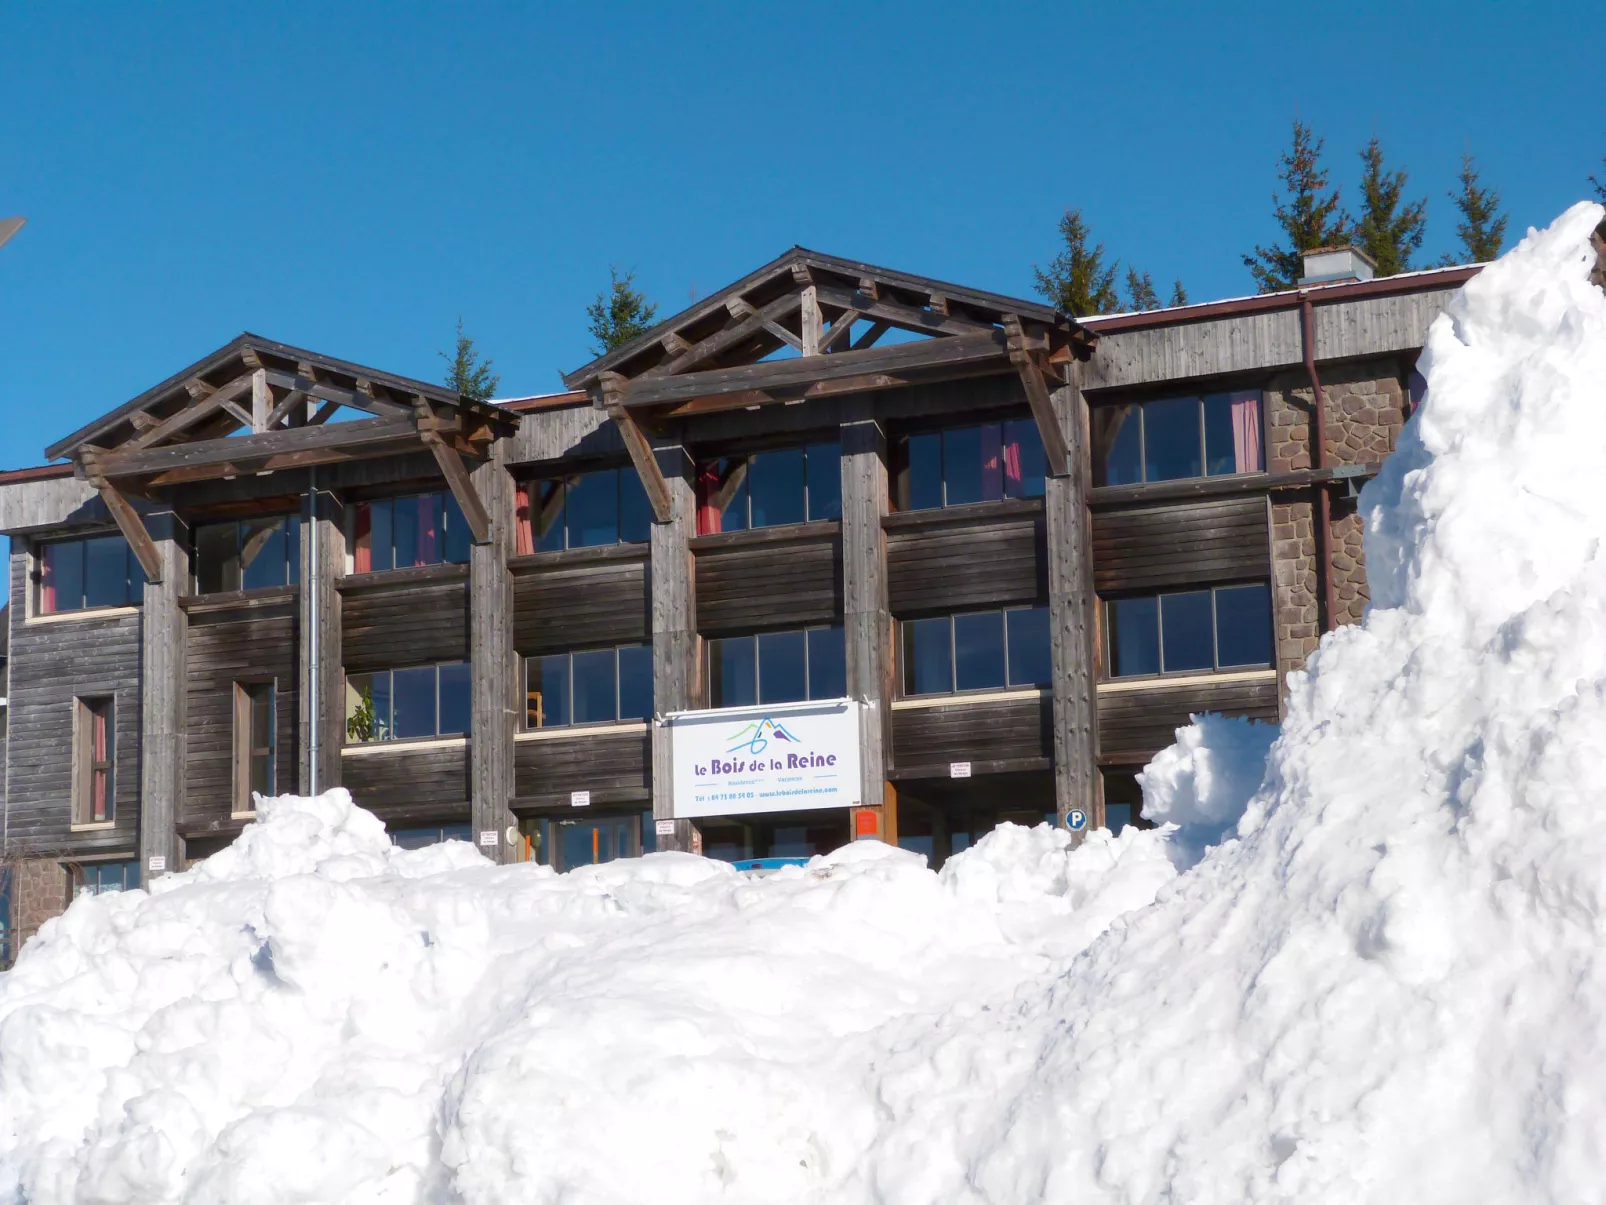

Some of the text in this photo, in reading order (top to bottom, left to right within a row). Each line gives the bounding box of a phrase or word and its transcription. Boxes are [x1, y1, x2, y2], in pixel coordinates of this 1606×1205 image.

[711, 756, 745, 775] Bois
[749, 760, 766, 772] de
[770, 758, 783, 770] la
[787, 751, 837, 769] Reine
[1071, 811, 1083, 827] P
